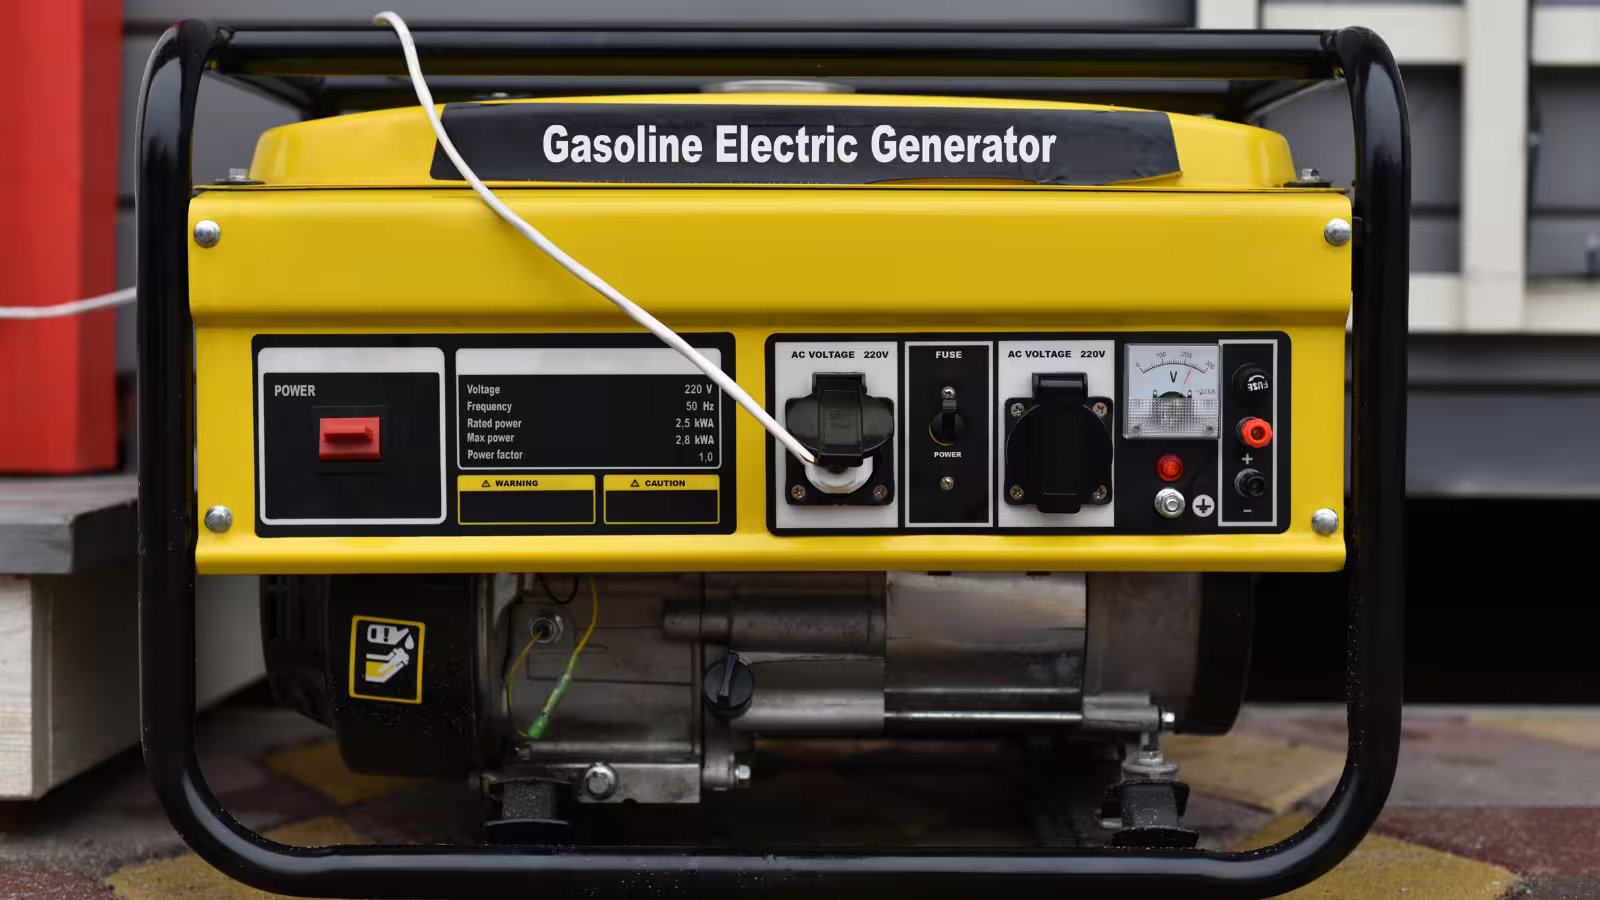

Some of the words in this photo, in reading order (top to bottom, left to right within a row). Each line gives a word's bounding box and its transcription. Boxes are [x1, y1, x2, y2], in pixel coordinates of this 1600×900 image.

[542, 124, 703, 164] Gasoline
[716, 124, 859, 164] Electric
[870, 124, 1057, 164] Generator
[791, 350, 806, 359] AC
[808, 350, 855, 359] VOLTAGE
[863, 350, 889, 359] 220V
[935, 350, 963, 359] FUSE
[1007, 350, 1023, 358] AC
[1025, 350, 1072, 358] VOLTAGE
[1080, 350, 1106, 358] 220V
[1156, 351, 1167, 359] 100
[1181, 351, 1193, 359] 200
[1169, 370, 1178, 383] V
[274, 384, 316, 397] POWER
[467, 384, 501, 396] Voltage
[684, 384, 703, 395] 220
[706, 384, 713, 394] V
[467, 401, 513, 414] Frequency
[686, 401, 698, 412] 50
[703, 401, 715, 411] Hz
[467, 418, 493, 429] Rated
[494, 419, 522, 431] power
[694, 417, 715, 429] kWA
[467, 432, 485, 443] Max
[488, 434, 515, 445] power
[694, 434, 715, 445] kWA
[467, 449, 494, 460] Power
[497, 449, 524, 460] factor
[495, 479, 539, 487] WARNING
[644, 479, 686, 487] CAUTION
